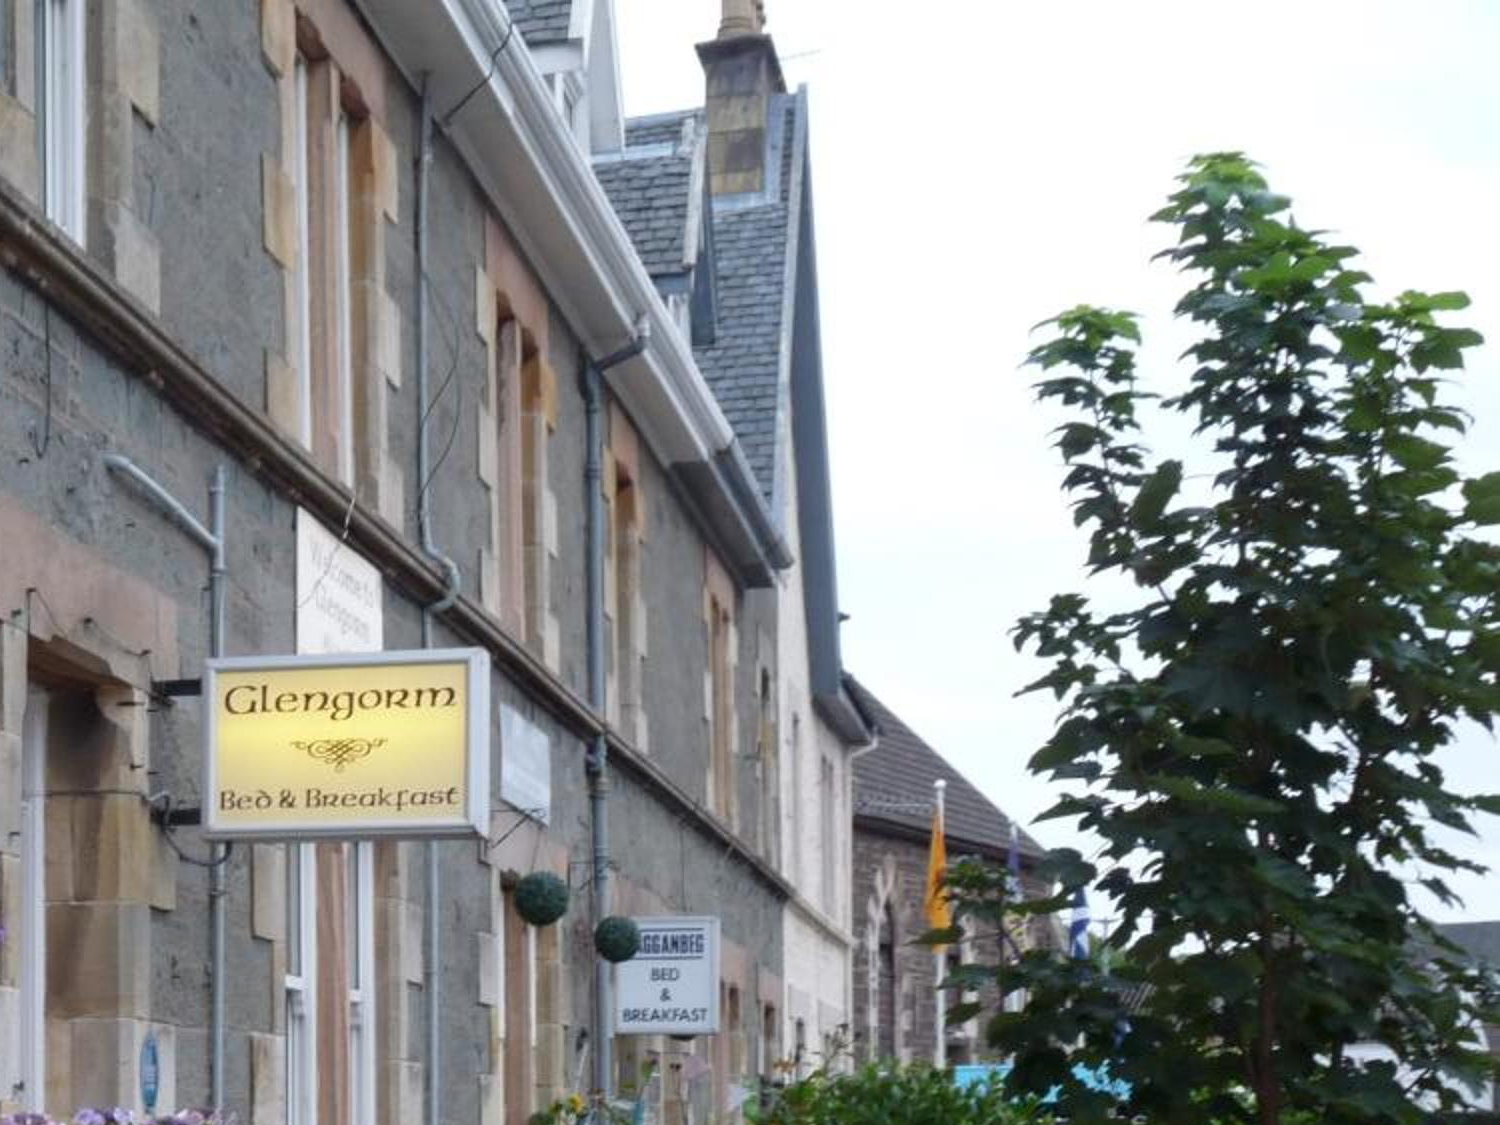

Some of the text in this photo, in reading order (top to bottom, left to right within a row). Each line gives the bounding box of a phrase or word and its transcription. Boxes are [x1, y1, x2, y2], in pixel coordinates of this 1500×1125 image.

[224, 684, 457, 721] Glengorm
[219, 785, 459, 812] Bed & Breakfast
[650, 967, 680, 982] BED
[659, 987, 673, 1002] &
[621, 1007, 708, 1023] BREAKFAST
